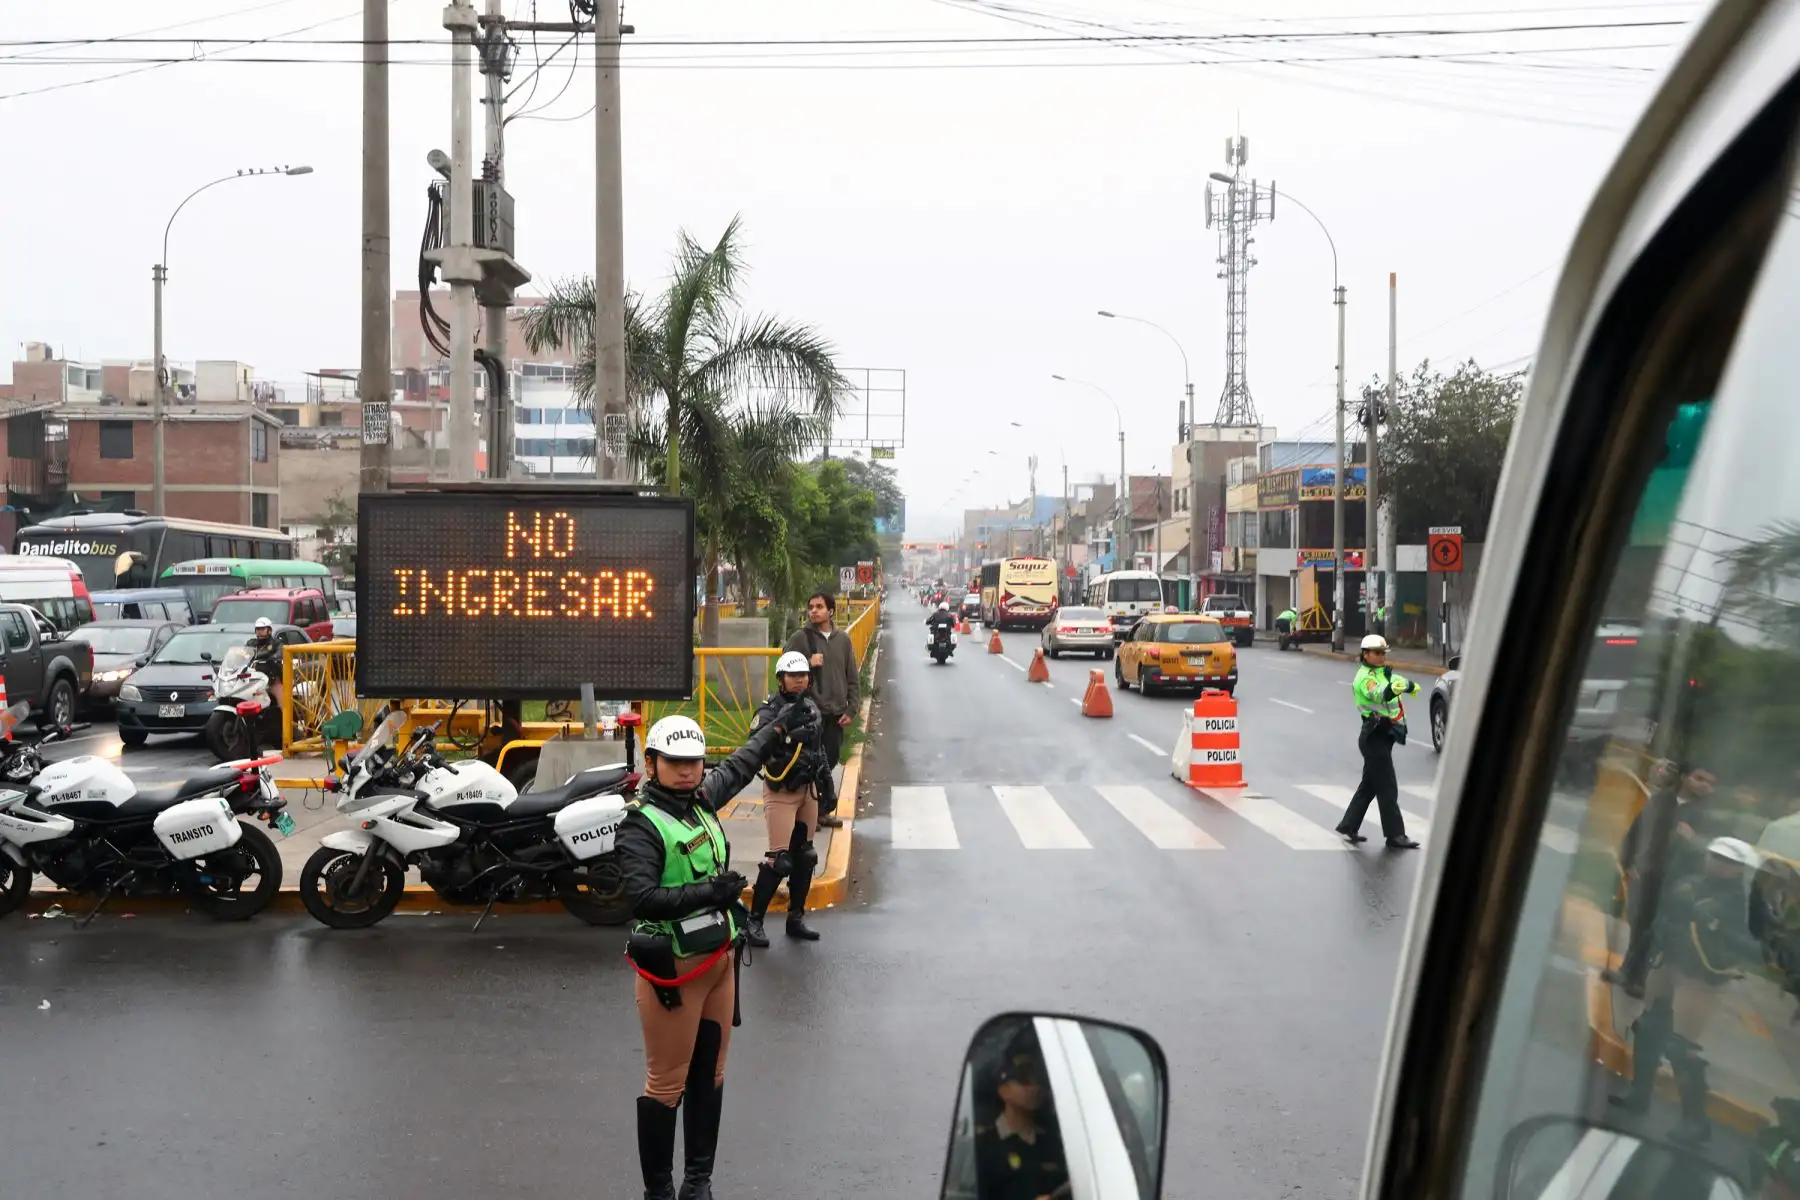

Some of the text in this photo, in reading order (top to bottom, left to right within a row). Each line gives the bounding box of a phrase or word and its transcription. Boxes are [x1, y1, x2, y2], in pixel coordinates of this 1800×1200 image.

[506, 511, 575, 558] NO
[19, 540, 117, 556] Danielitobus
[393, 569, 653, 618] INGRESAR
[1205, 719, 1236, 731] POLICIA
[666, 729, 705, 747] POLICIA
[1207, 750, 1237, 762] POLICIA
[169, 824, 214, 844] TRANSITO
[572, 822, 620, 845] POLICIA
